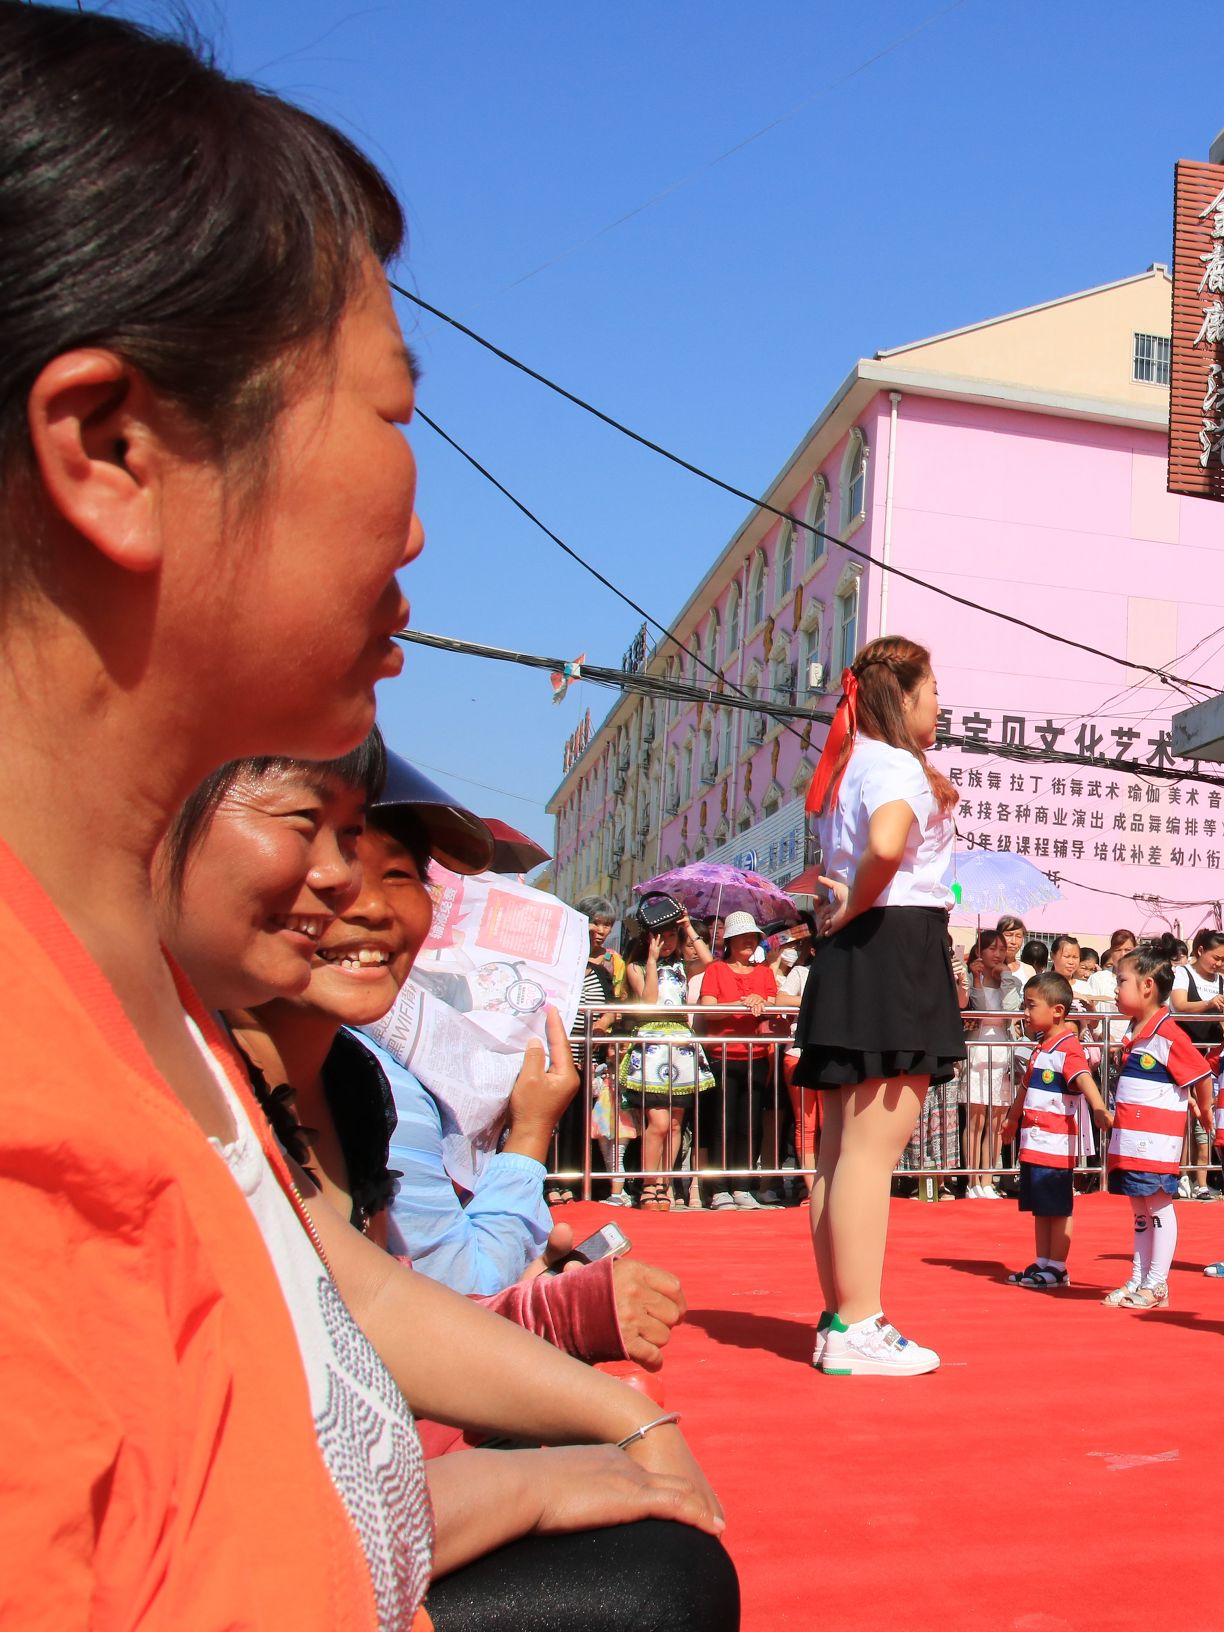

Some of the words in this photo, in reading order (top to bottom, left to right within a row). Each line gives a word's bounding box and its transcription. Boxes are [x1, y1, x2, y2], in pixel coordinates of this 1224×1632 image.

[936, 707, 1224, 774] 宝贝文化艺术
[949, 767, 1002, 791] 民族舞
[1009, 773, 1043, 794] 拉丁
[1051, 777, 1120, 800] 街舞武术
[1127, 783, 1160, 804] 瑜伽
[1168, 786, 1200, 807] 美术
[958, 799, 1104, 829] 承接各种商业演出
[1093, 841, 1162, 865] 培优补差
